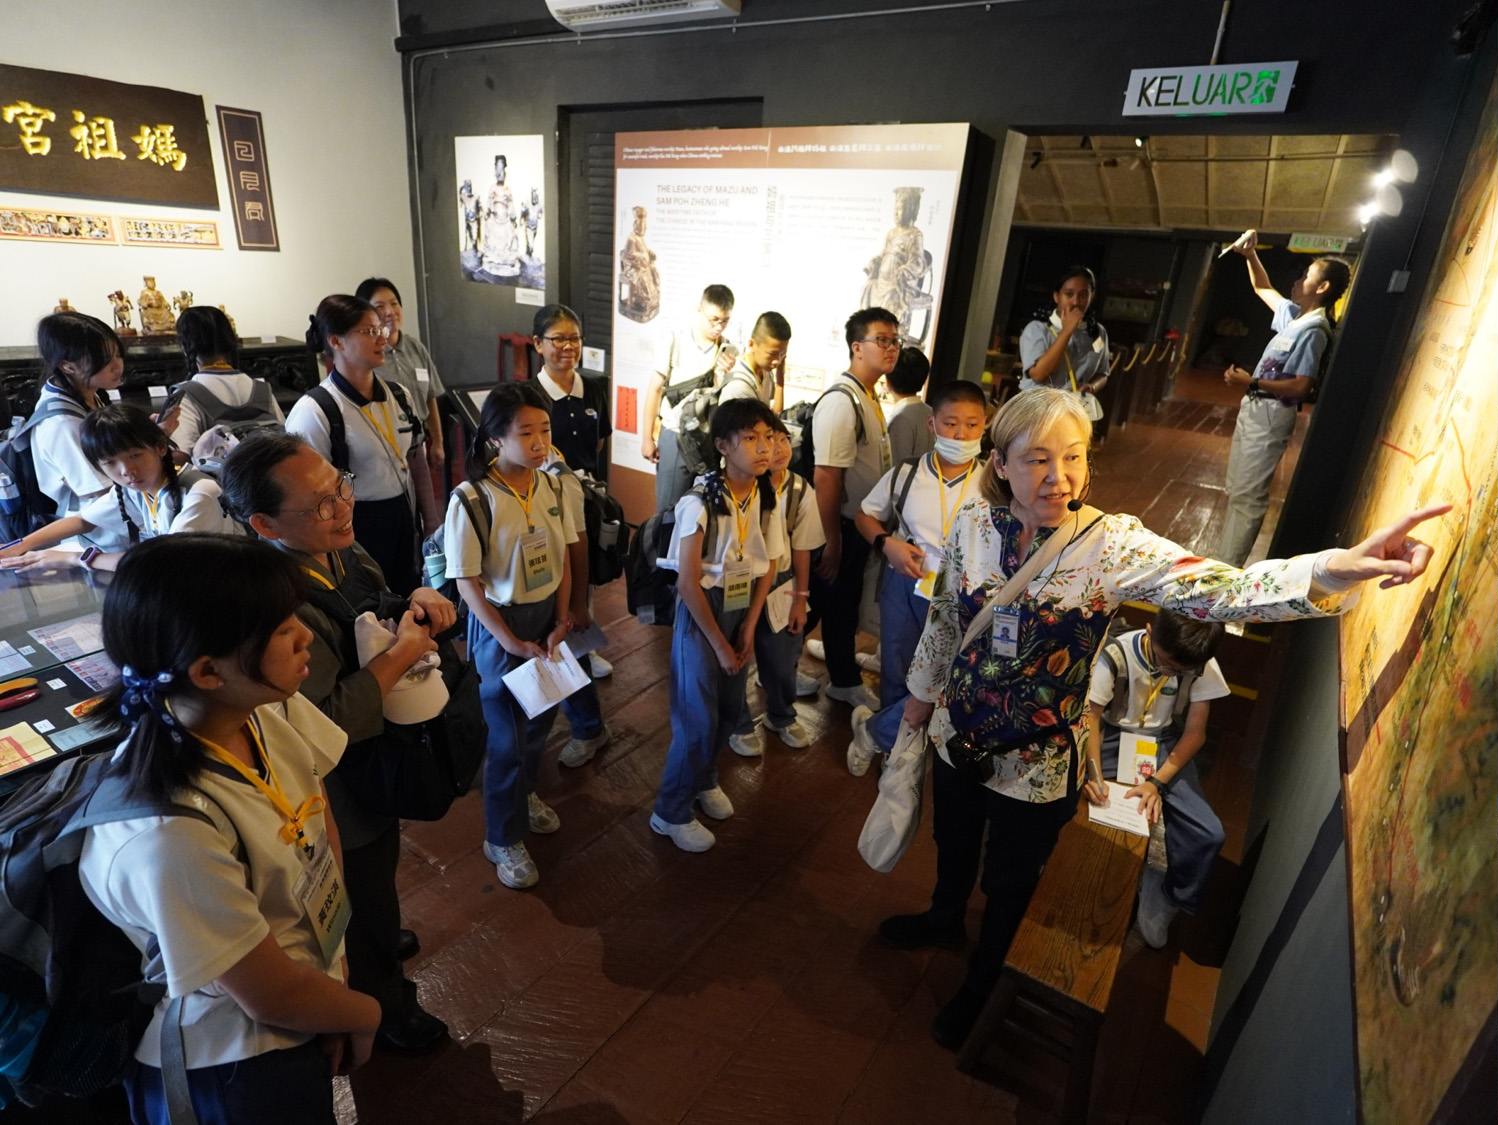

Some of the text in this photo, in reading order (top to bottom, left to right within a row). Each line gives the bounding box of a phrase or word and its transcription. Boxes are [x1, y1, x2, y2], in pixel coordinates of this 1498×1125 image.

[1136, 71, 1254, 108] KELUAR
[656, 184, 758, 195] THE LEGACY OF MAZU AND
[656, 197, 731, 207] SAM POH ZHENG HE
